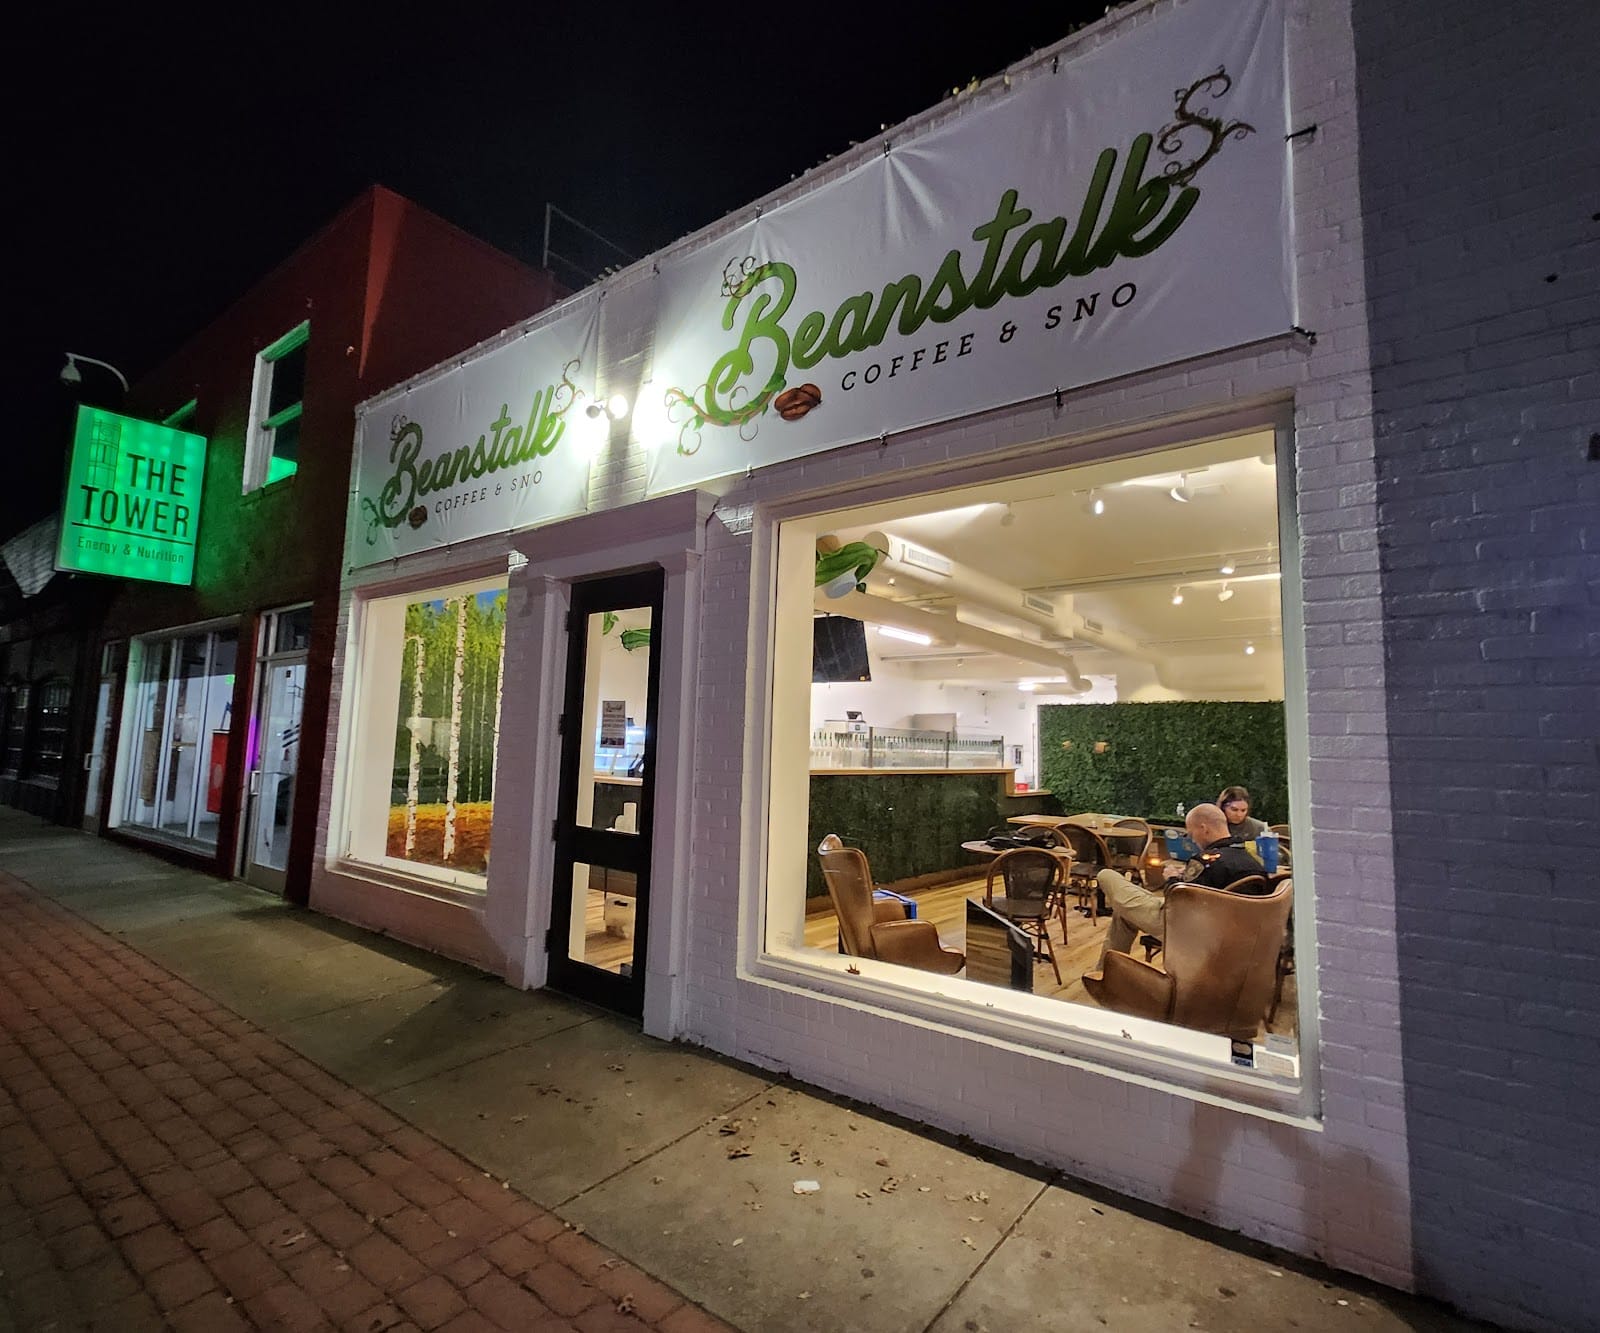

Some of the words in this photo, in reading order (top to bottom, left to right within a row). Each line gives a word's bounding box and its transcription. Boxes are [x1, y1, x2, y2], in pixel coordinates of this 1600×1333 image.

[704, 132, 1201, 427] Beanstalk
[841, 333, 975, 391] COFFEE
[999, 320, 1018, 343] &
[1044, 282, 1137, 330] SNO
[126, 452, 188, 498] THE
[379, 384, 566, 529] Beanstalk
[80, 484, 191, 538] TOWER
[435, 487, 487, 514] COFFEE
[494, 486, 503, 497] &
[510, 470, 543, 492] SNO
[77, 536, 117, 554] Energy
[122, 543, 132, 557] &
[137, 545, 184, 564] Nutrition
